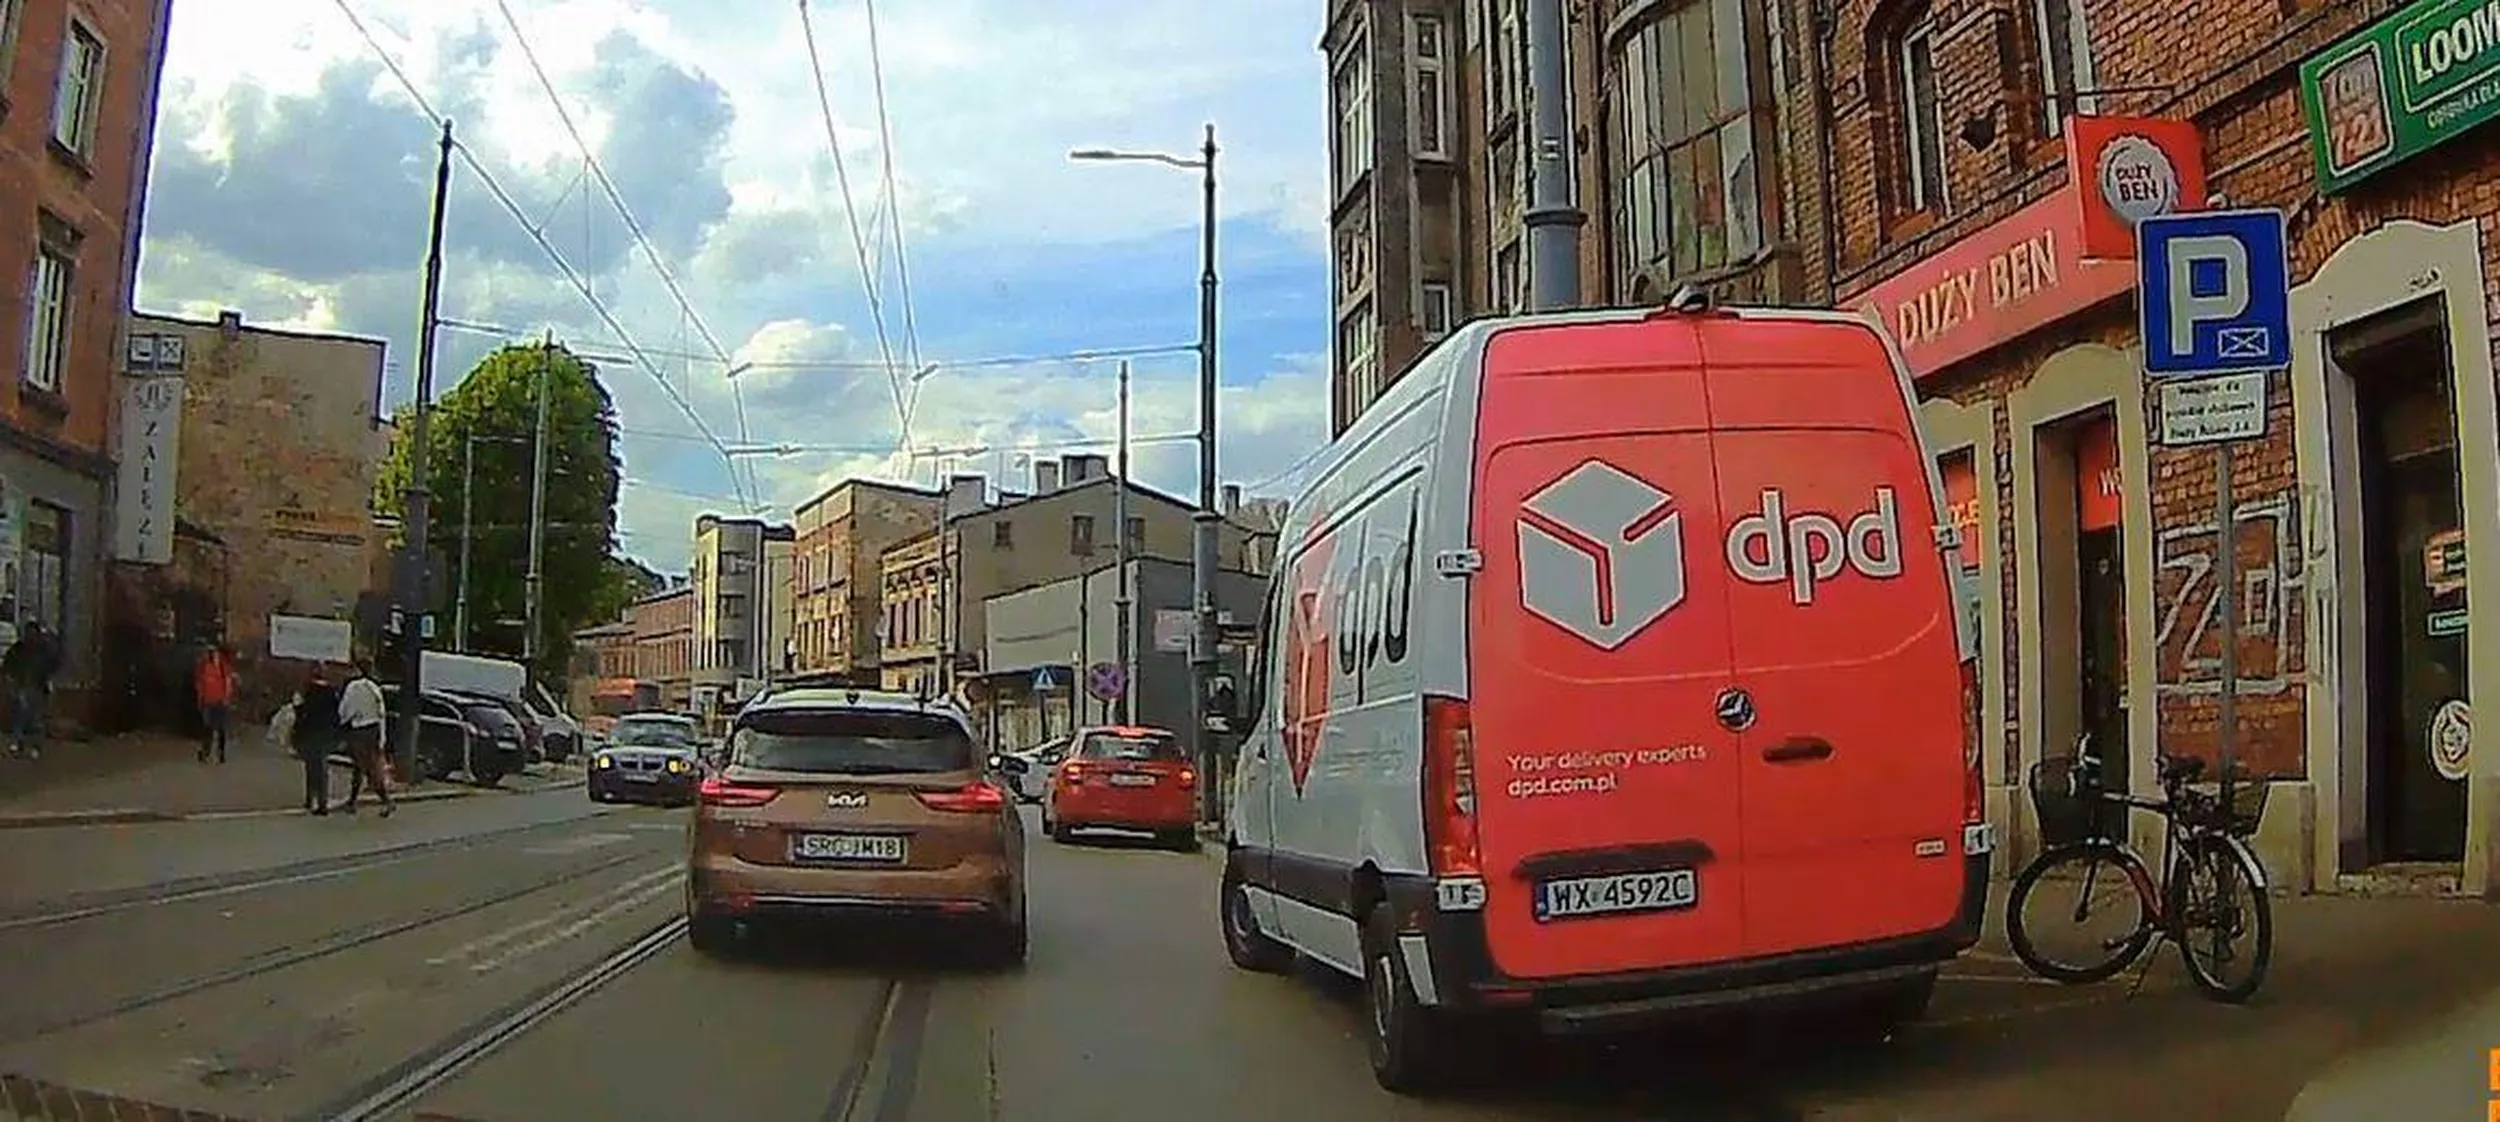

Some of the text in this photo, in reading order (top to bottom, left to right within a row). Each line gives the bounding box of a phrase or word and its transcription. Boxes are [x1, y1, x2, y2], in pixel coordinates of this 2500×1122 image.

[2119, 180, 2159, 201] BEN
[1900, 229, 2062, 350] DUŻY BEN
[2168, 235, 2250, 356] P
[1726, 487, 1903, 604] dpd
[1507, 754, 1556, 771] Your
[1558, 751, 1634, 769] delivery
[1507, 771, 1619, 799] dpd.com.pl
[1554, 873, 1689, 912] WX 4592C
